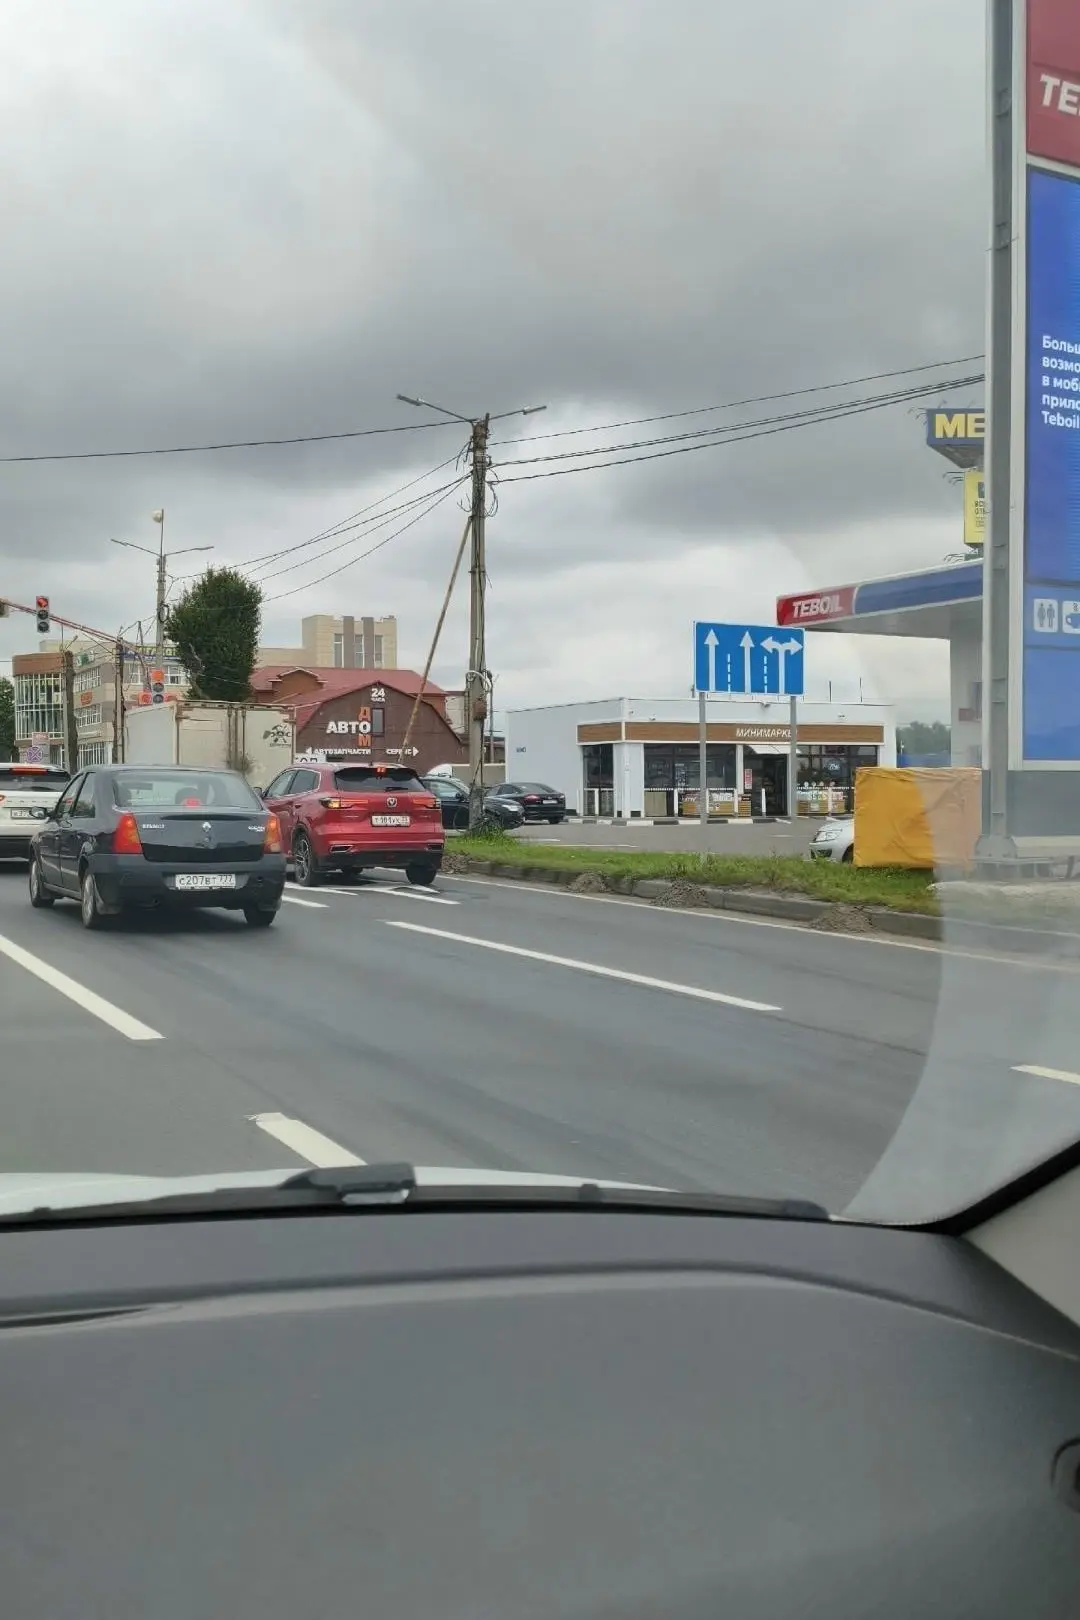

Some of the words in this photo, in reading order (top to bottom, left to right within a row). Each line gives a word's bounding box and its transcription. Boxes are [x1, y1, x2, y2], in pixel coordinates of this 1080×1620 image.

[1040, 74, 1080, 116] TE
[1042, 376, 1050, 386] в
[1053, 377, 1080, 392] моб
[1041, 410, 1080, 429] Teboil
[792, 594, 844, 619] TEBOIL
[371, 688, 385, 697] 24
[326, 721, 372, 734] АВТО
[736, 728, 798, 738] МИНИМАРКЕ
